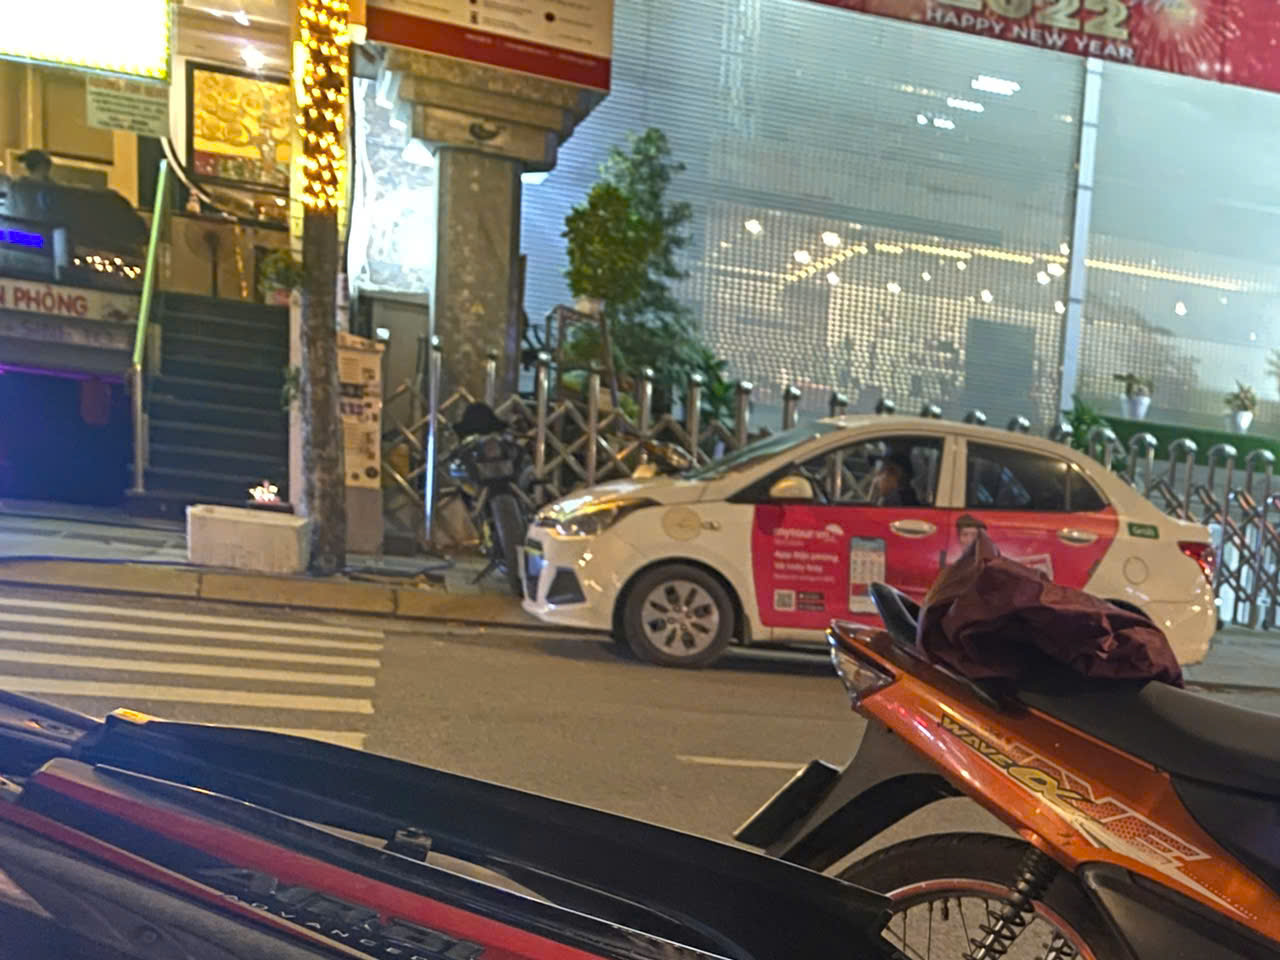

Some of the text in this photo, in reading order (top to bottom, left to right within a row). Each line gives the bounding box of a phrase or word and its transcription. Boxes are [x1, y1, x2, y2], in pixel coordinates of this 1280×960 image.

[926, 6, 1135, 62] HAPPY NEW YEAR
[935, 0, 1128, 39] 22
[13, 284, 89, 316] PHÒNG
[939, 713, 1016, 769] WAVE
